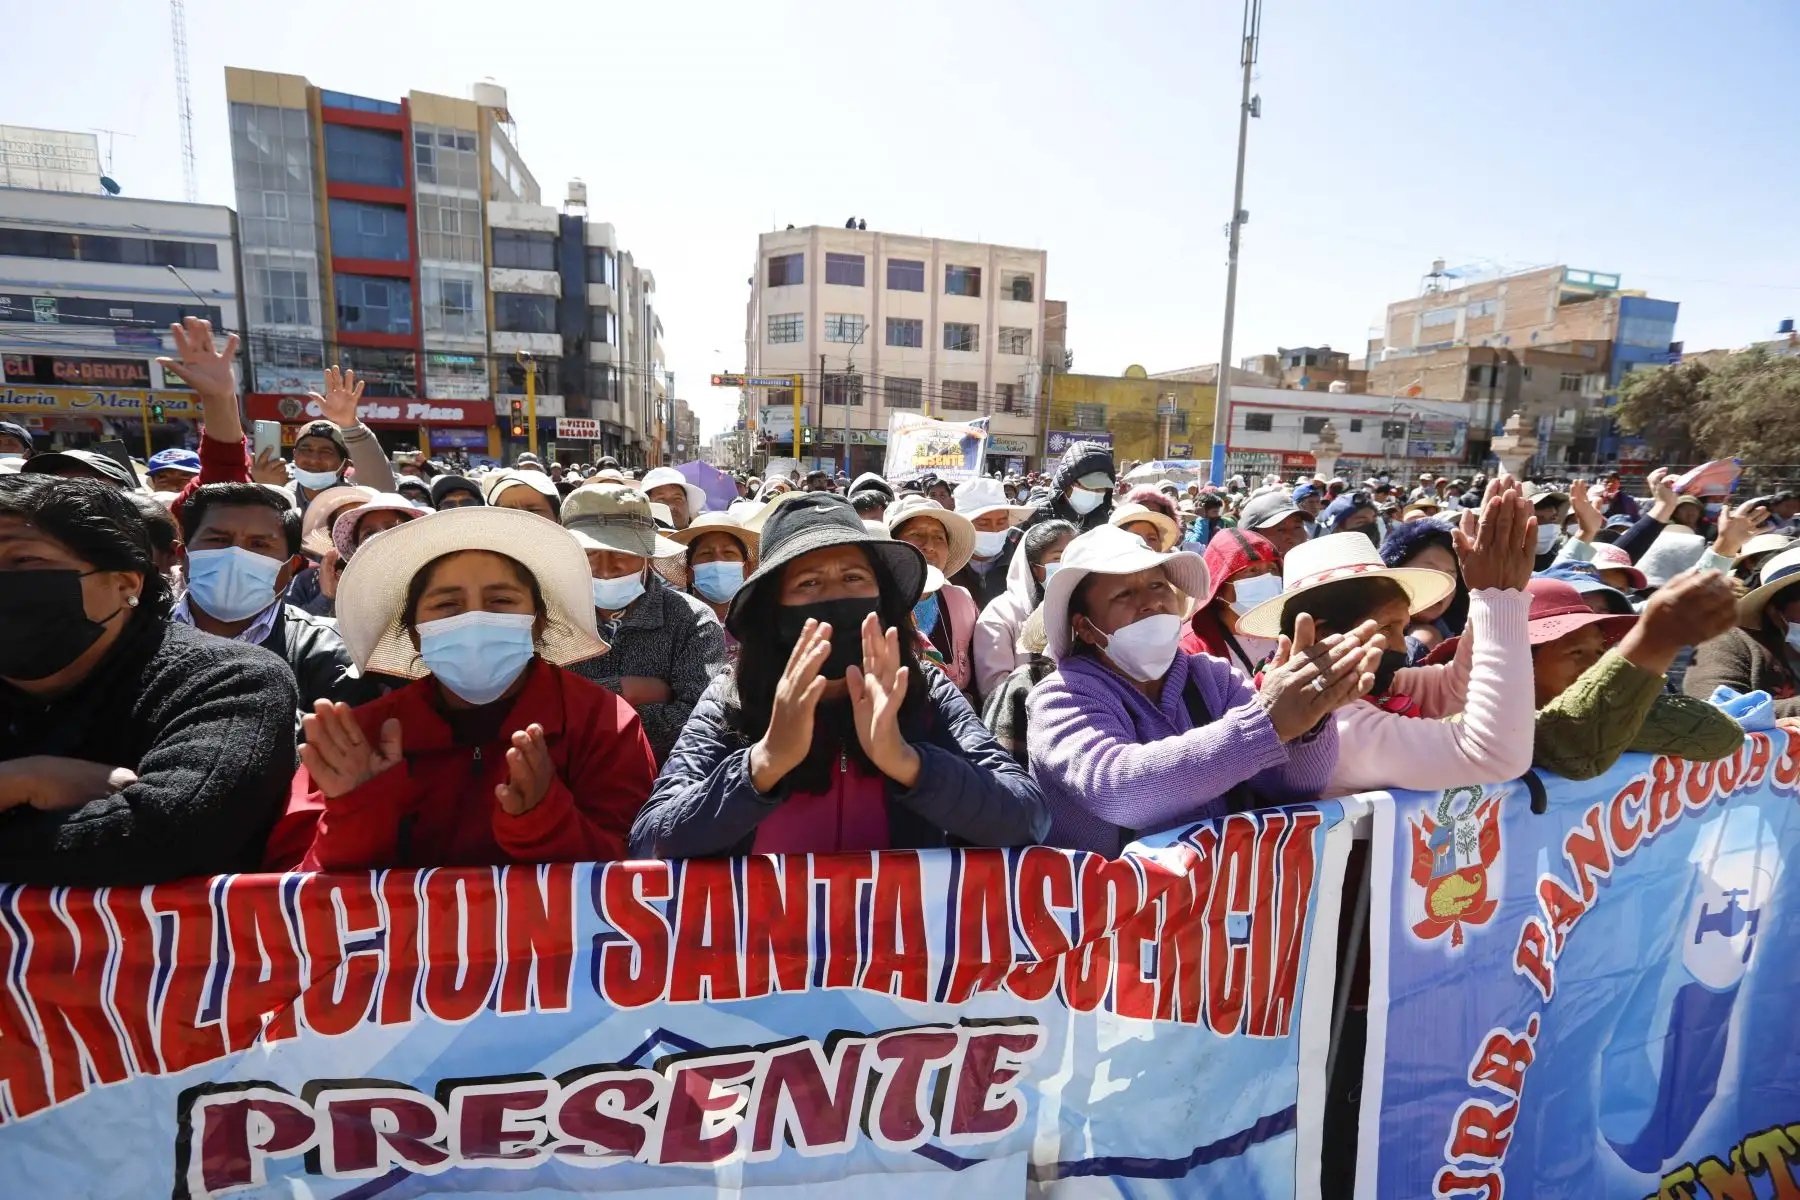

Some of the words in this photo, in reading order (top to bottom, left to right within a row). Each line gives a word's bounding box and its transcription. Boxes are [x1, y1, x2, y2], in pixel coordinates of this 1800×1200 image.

[81, 362, 148, 380] DENTAL
[559, 429, 599, 437] HELADOS
[595, 852, 928, 1009] SANTA
[178, 1018, 1046, 1198] PRESENTE
